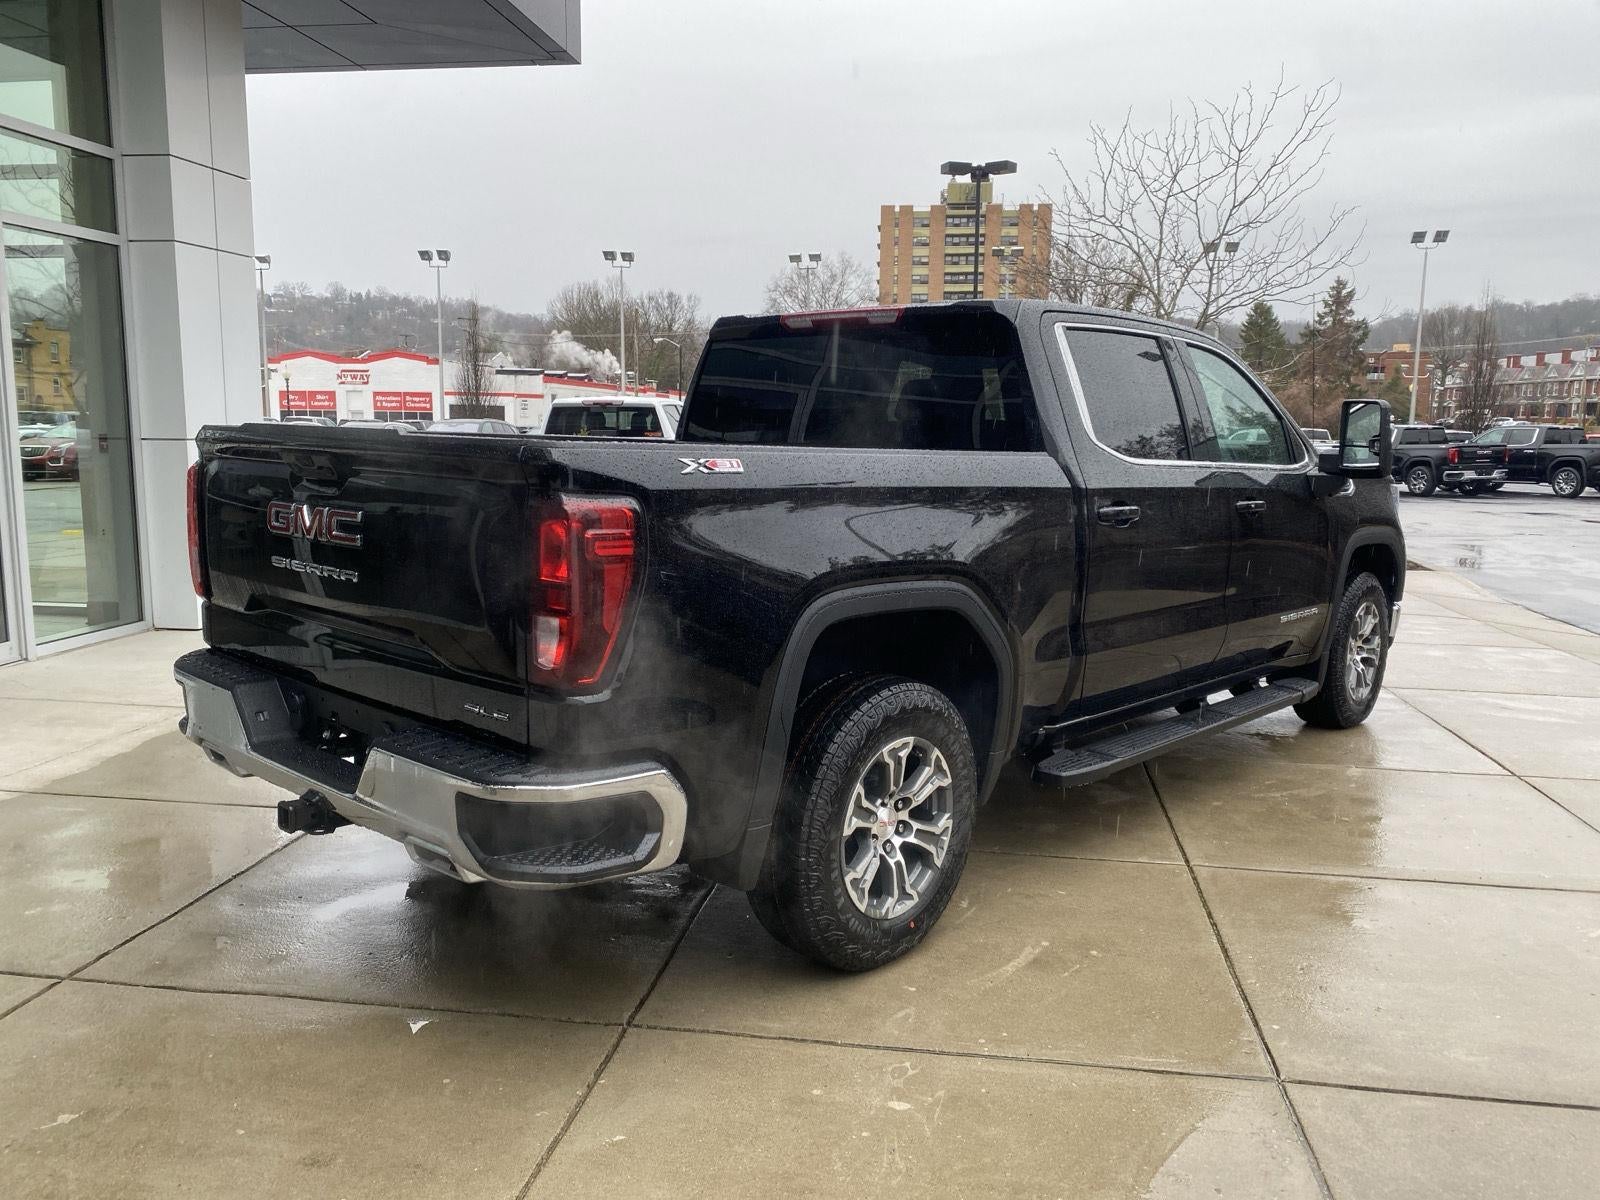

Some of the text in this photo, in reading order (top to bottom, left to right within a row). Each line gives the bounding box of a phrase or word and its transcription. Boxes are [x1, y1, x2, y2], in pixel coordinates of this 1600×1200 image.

[266, 500, 363, 548] GMC
[270, 555, 358, 583] SIERRA
[1280, 607, 1319, 623] SIERRA
